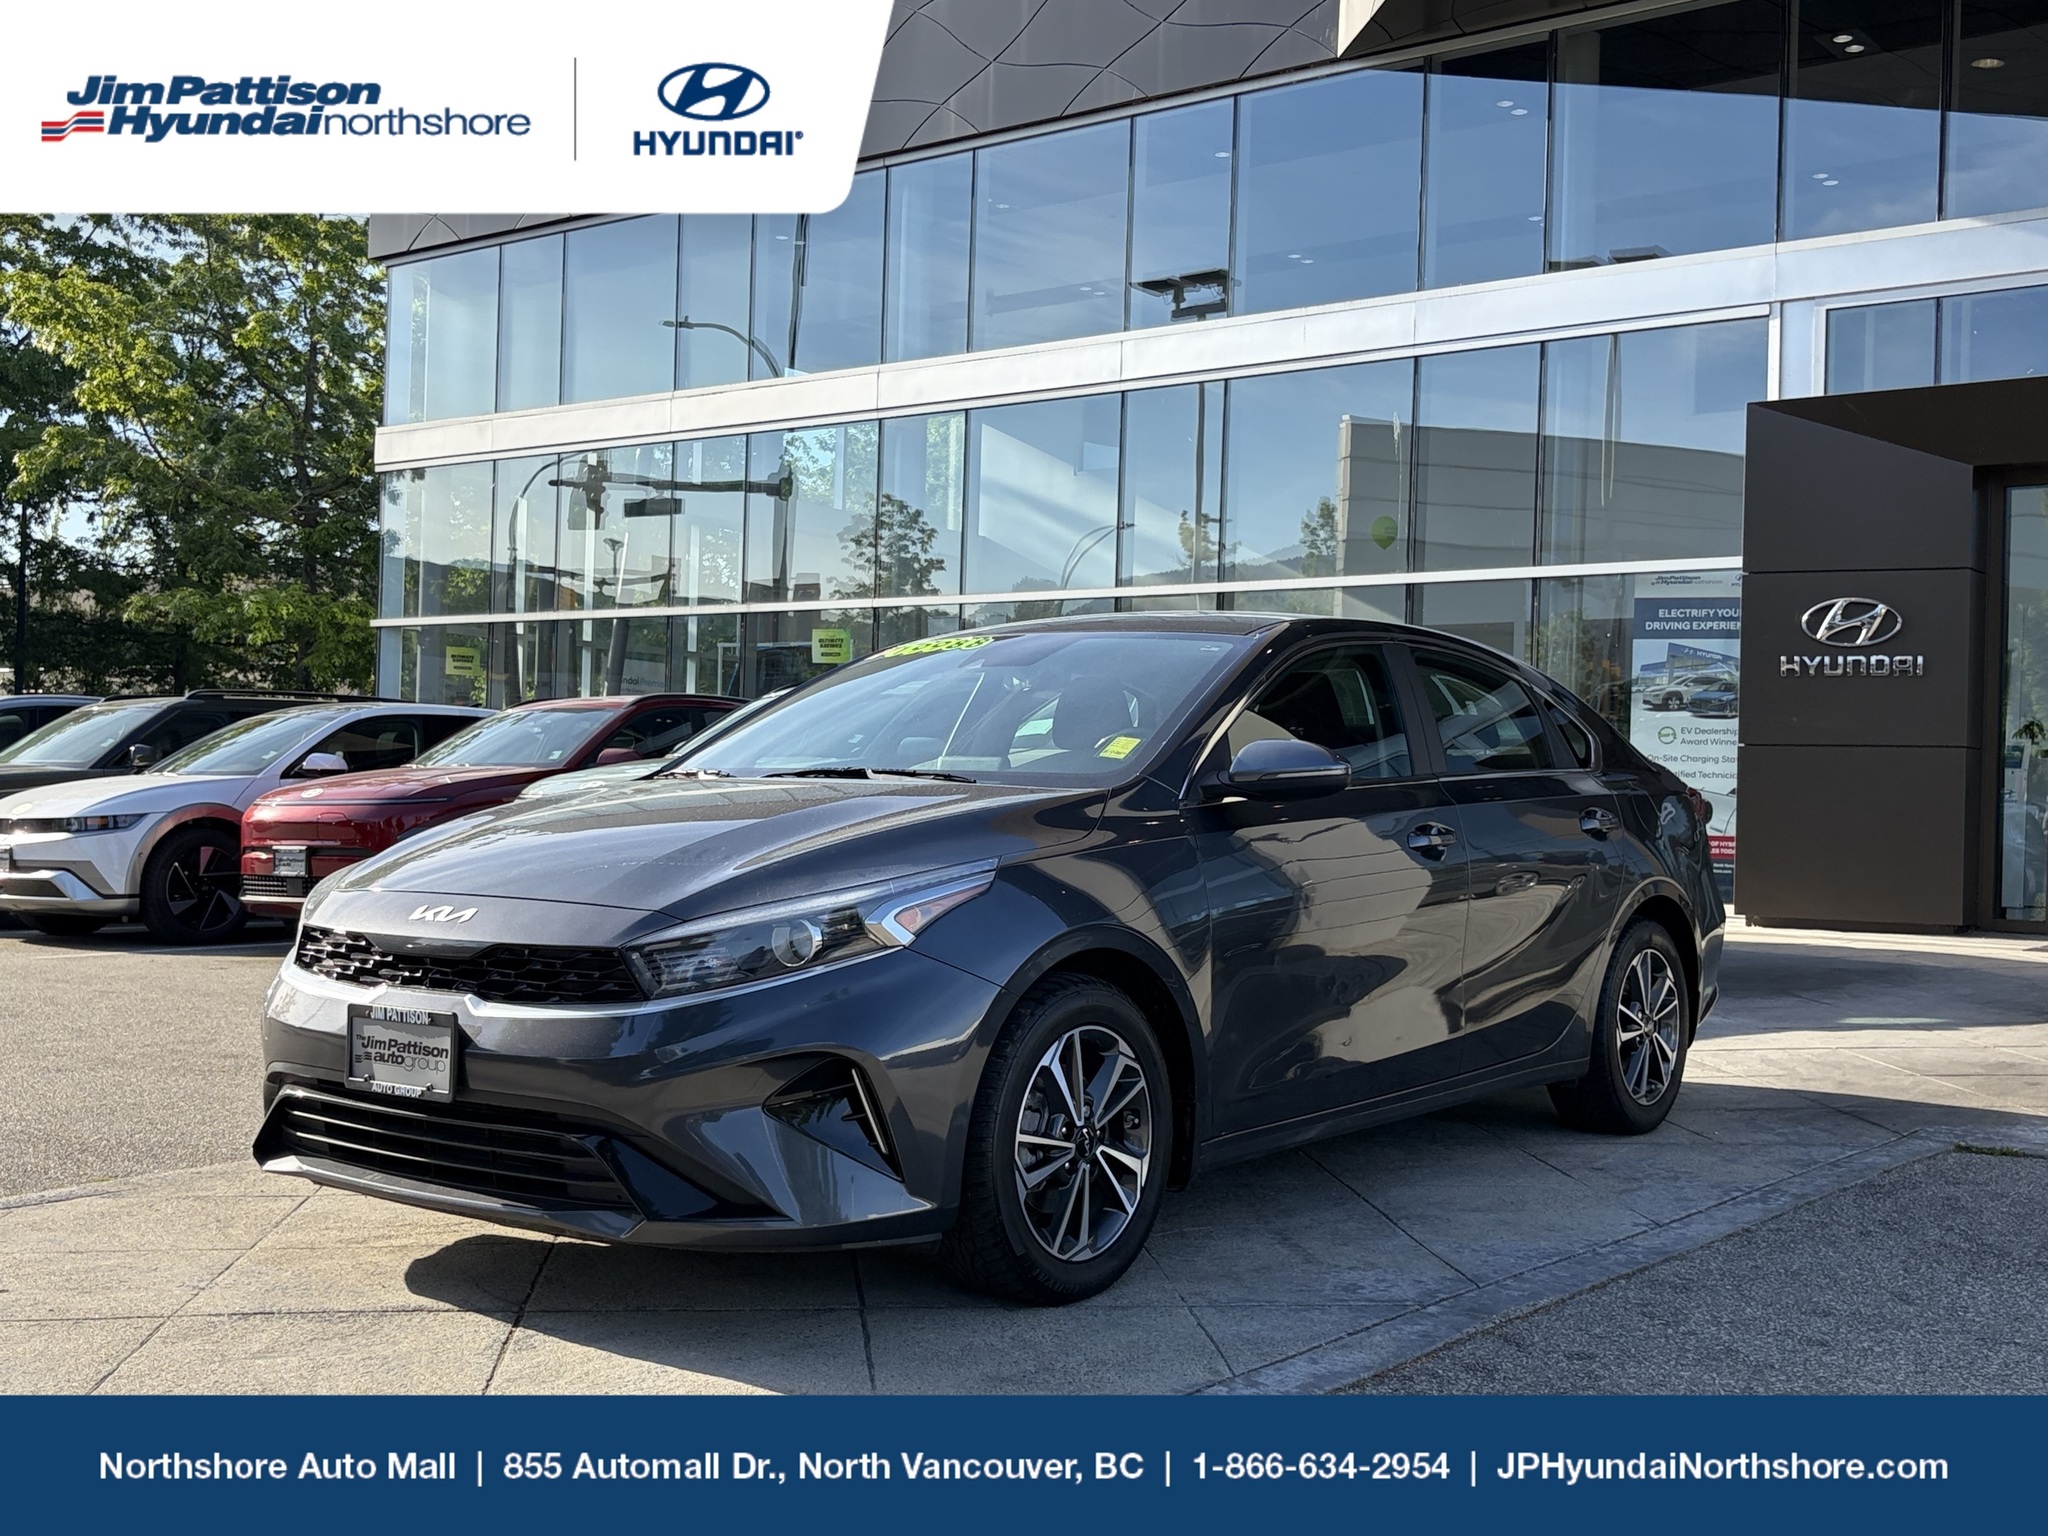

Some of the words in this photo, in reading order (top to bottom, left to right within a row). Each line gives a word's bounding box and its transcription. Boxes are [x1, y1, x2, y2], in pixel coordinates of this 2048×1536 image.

[1658, 608, 1715, 618] ELECTRIFY
[1645, 621, 1691, 631] DRIVING
[1780, 655, 1924, 677] HYUNDAI
[1680, 727, 1693, 735] EV
[1680, 738, 1708, 746] Award
[1680, 755, 1719, 765] Charging
[370, 1006, 385, 1020] JIM
[387, 1008, 429, 1025] PATTISON
[371, 1082, 393, 1094] AUTO
[394, 1085, 422, 1098] GROUP
